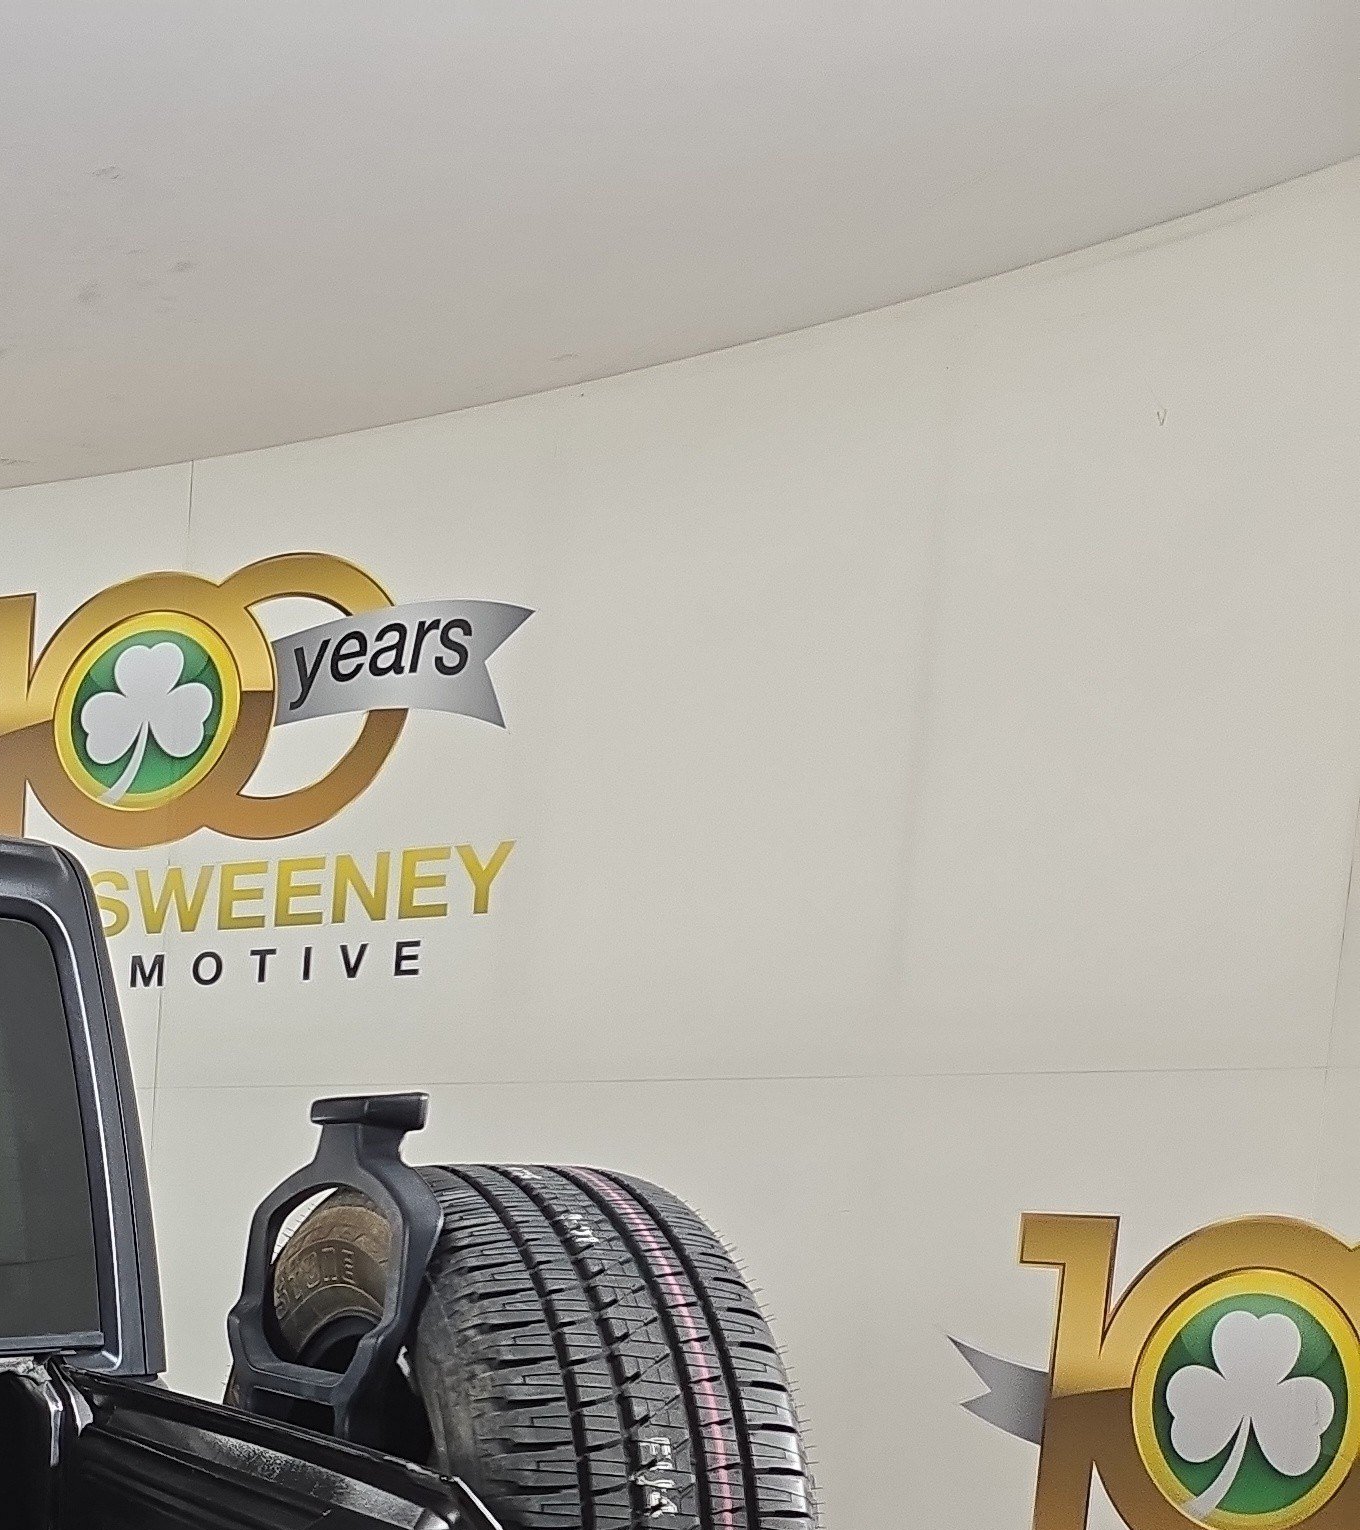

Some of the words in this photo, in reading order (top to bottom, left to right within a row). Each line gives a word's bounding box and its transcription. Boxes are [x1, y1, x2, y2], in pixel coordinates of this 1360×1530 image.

[288, 613, 474, 711] years
[90, 839, 517, 938] SWEENEY
[129, 939, 422, 989] MOTIVE
